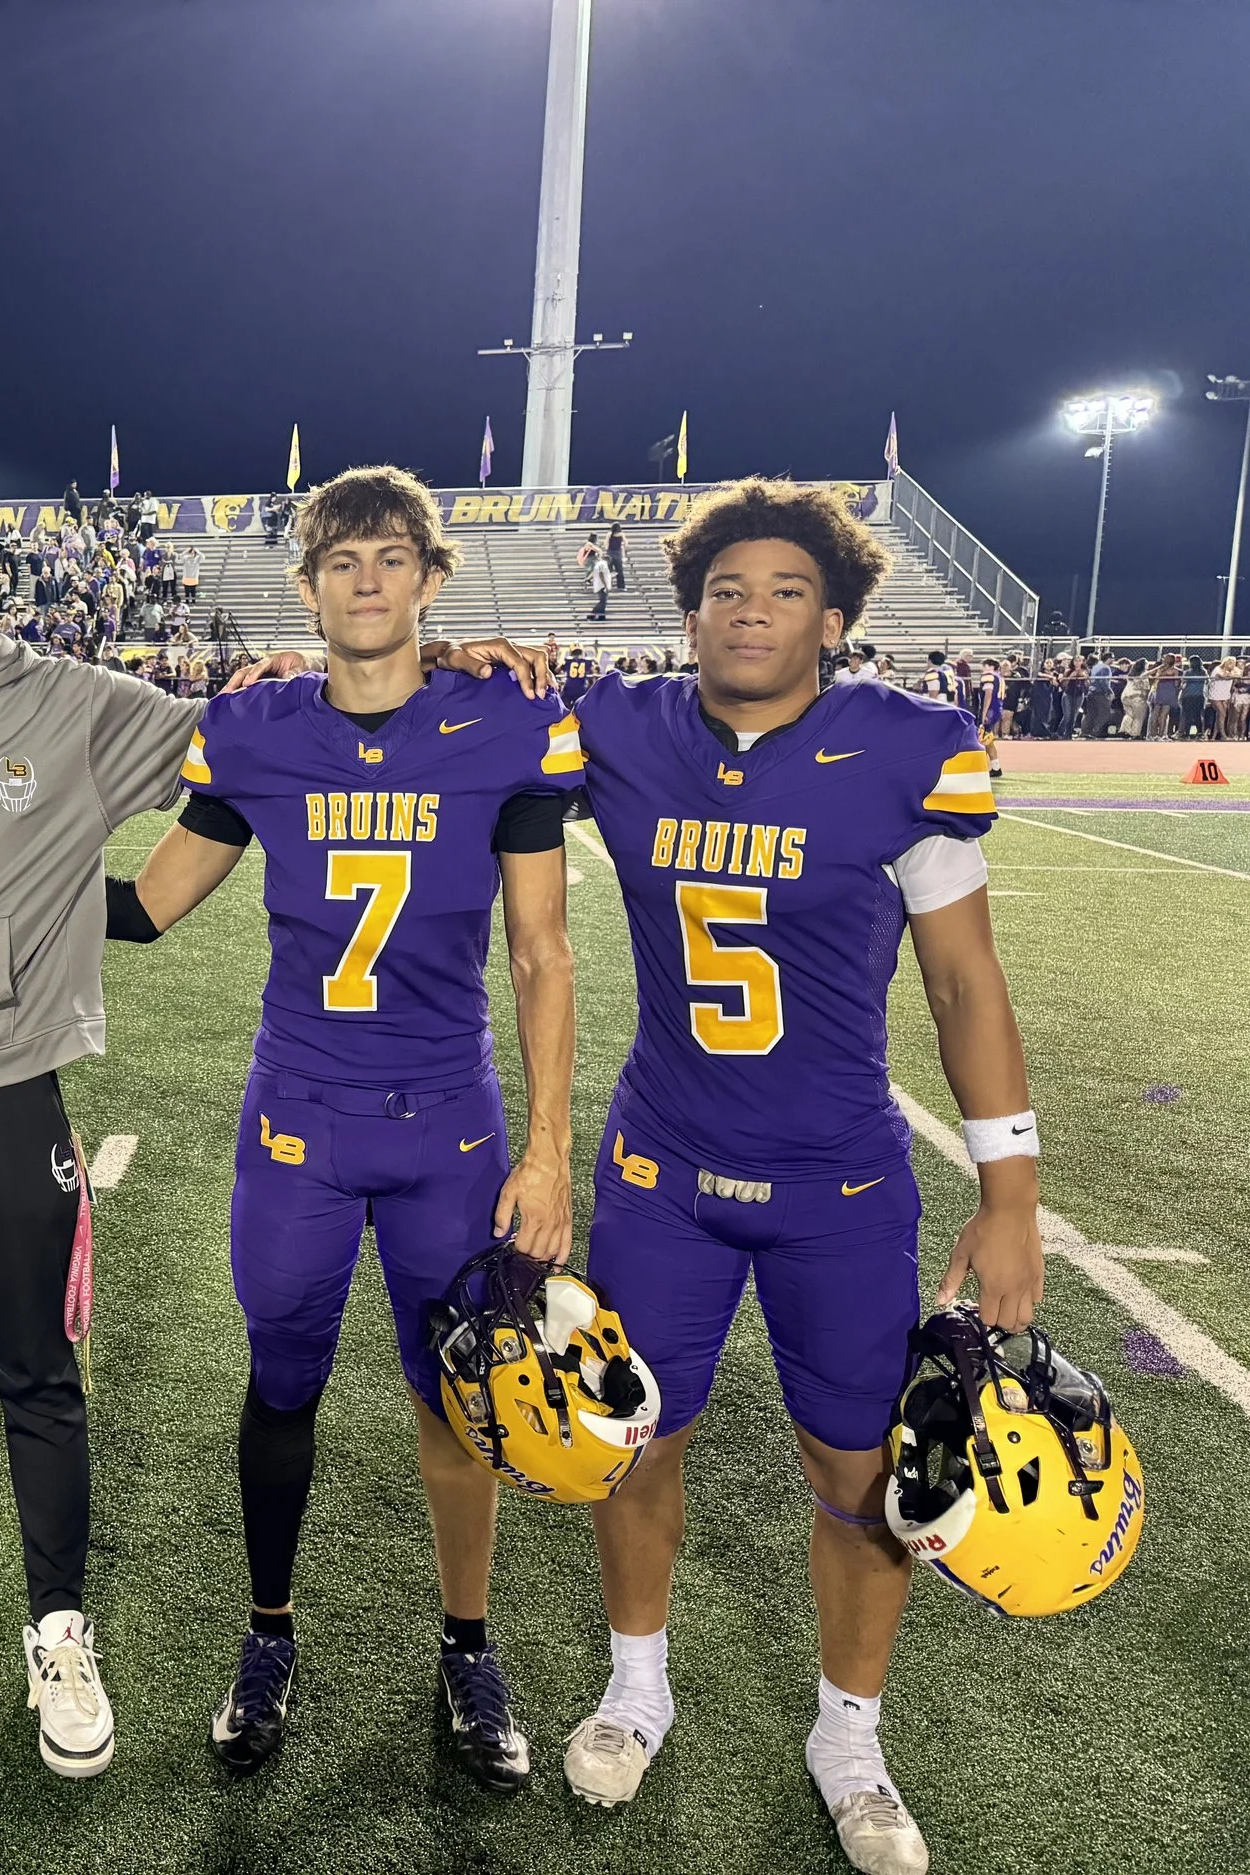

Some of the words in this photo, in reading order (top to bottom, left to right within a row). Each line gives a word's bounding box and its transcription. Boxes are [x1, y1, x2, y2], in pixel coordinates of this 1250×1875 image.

[448, 492, 579, 523] BRUIN
[570, 662, 585, 678] 64
[1199, 761, 1219, 781] 10
[305, 792, 441, 842] BRUINS
[651, 817, 807, 880] BRUINS
[322, 850, 412, 1012] 7
[675, 880, 785, 1056] 5
[69, 1245, 83, 1283] VIRGINIA
[82, 1252, 91, 1297] FOOTBALL
[66, 1284, 77, 1328] FOOTBALL
[1089, 1467, 1145, 1577] Bruins
